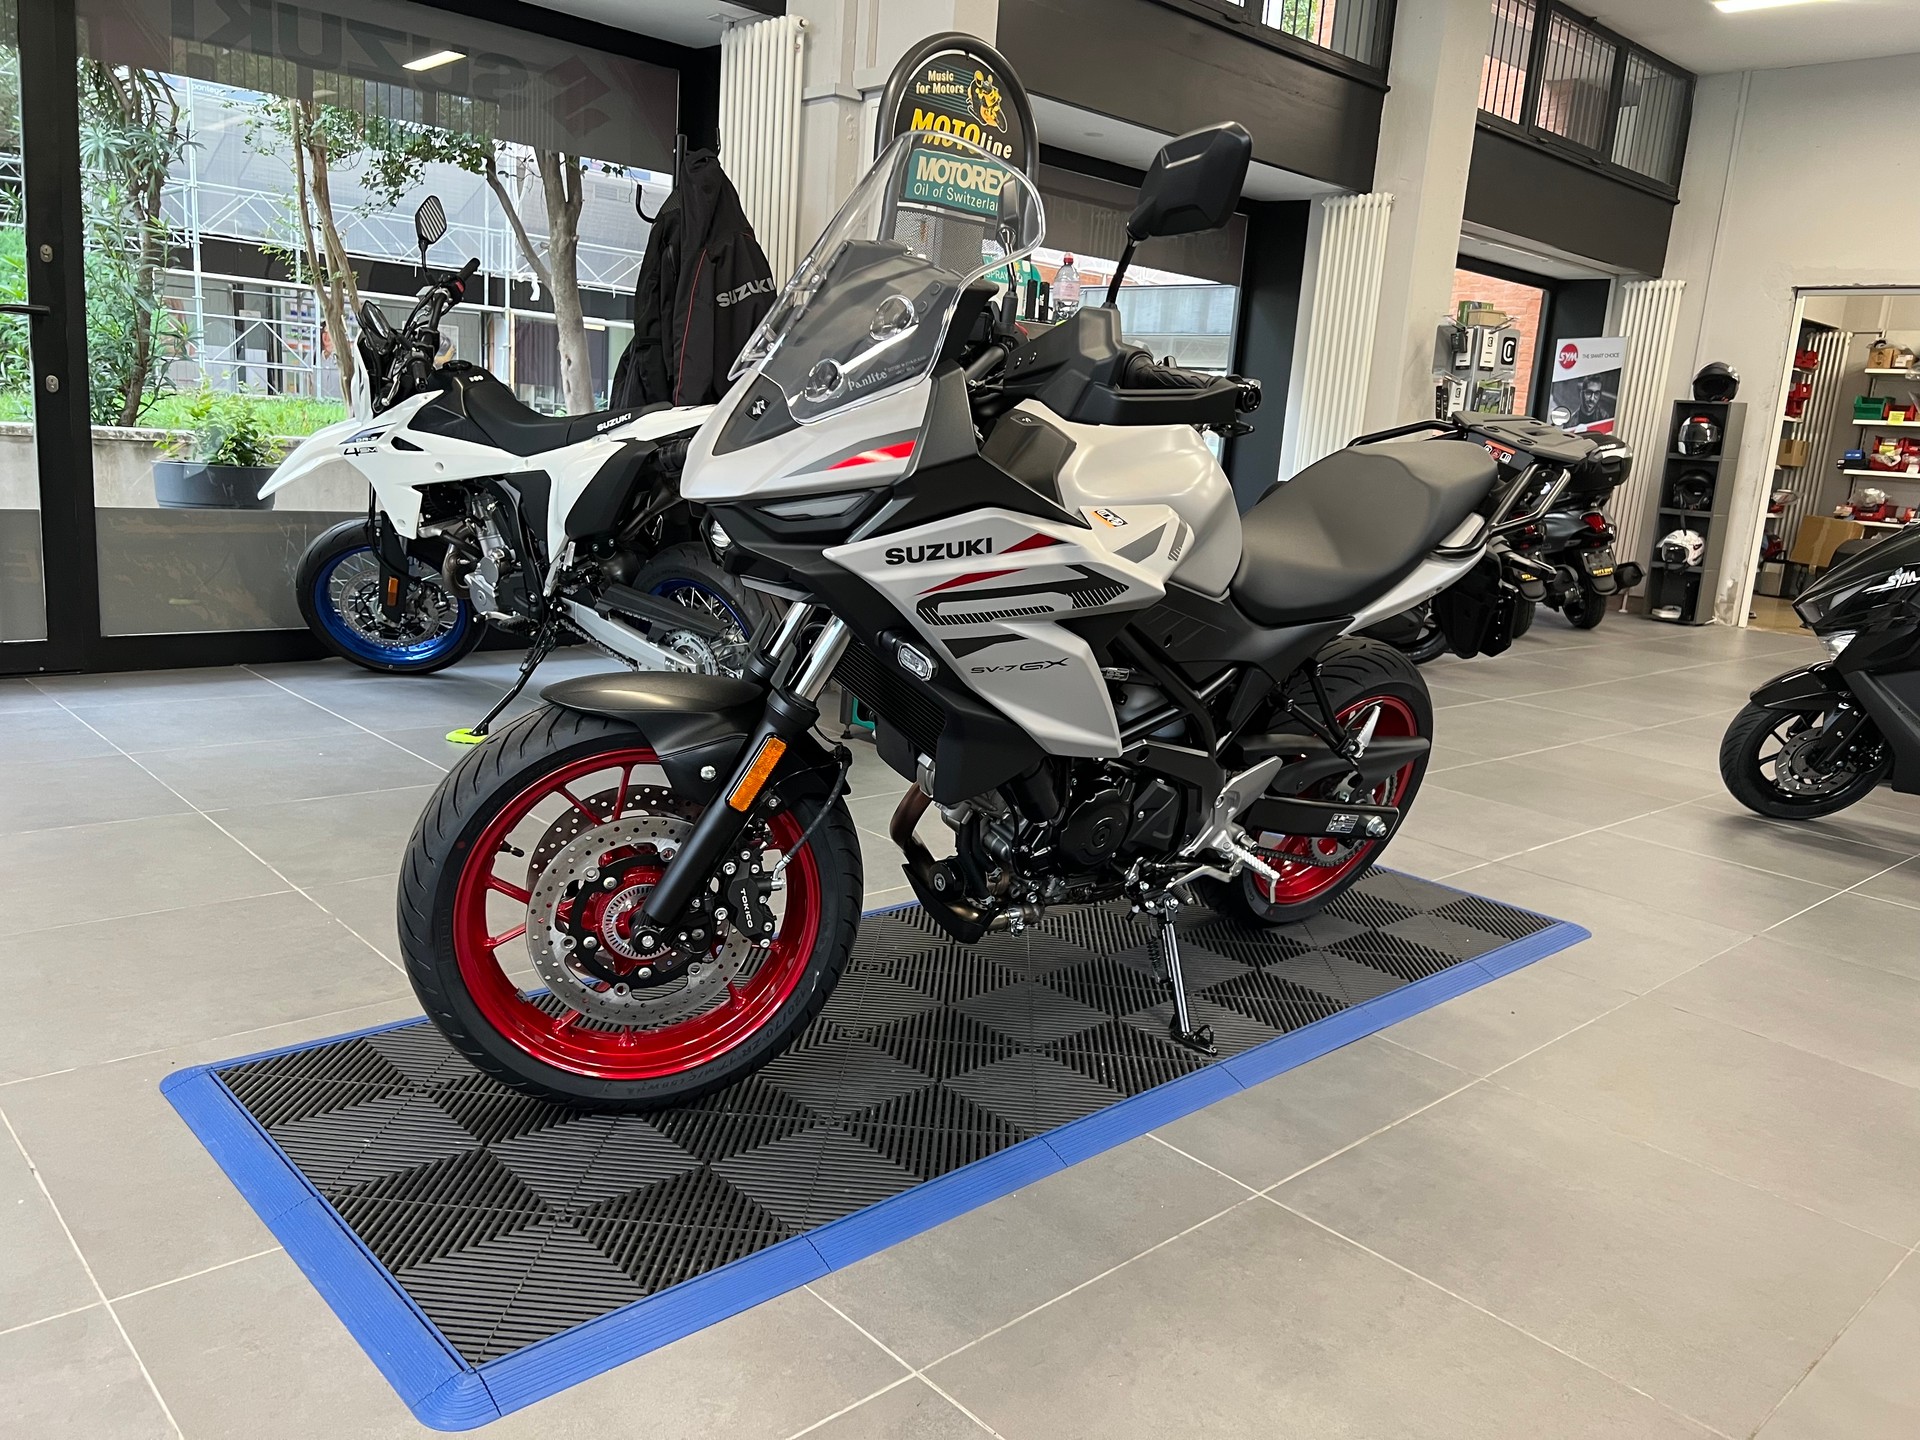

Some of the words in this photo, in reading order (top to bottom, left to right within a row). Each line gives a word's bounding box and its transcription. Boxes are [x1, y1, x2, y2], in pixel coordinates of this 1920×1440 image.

[928, 70, 954, 81] Music
[916, 82, 931, 94] for
[932, 83, 964, 94] Motors
[914, 182, 929, 196] Oil
[932, 186, 944, 198] of
[946, 187, 999, 212] Switzerla
[716, 277, 775, 307] SUZUKI
[1559, 352, 1577, 364] SYM
[847, 371, 888, 391] Panlite
[596, 412, 632, 431] SUZUKI
[885, 537, 992, 565] SUZUKI
[740, 888, 754, 928] TOKICO
